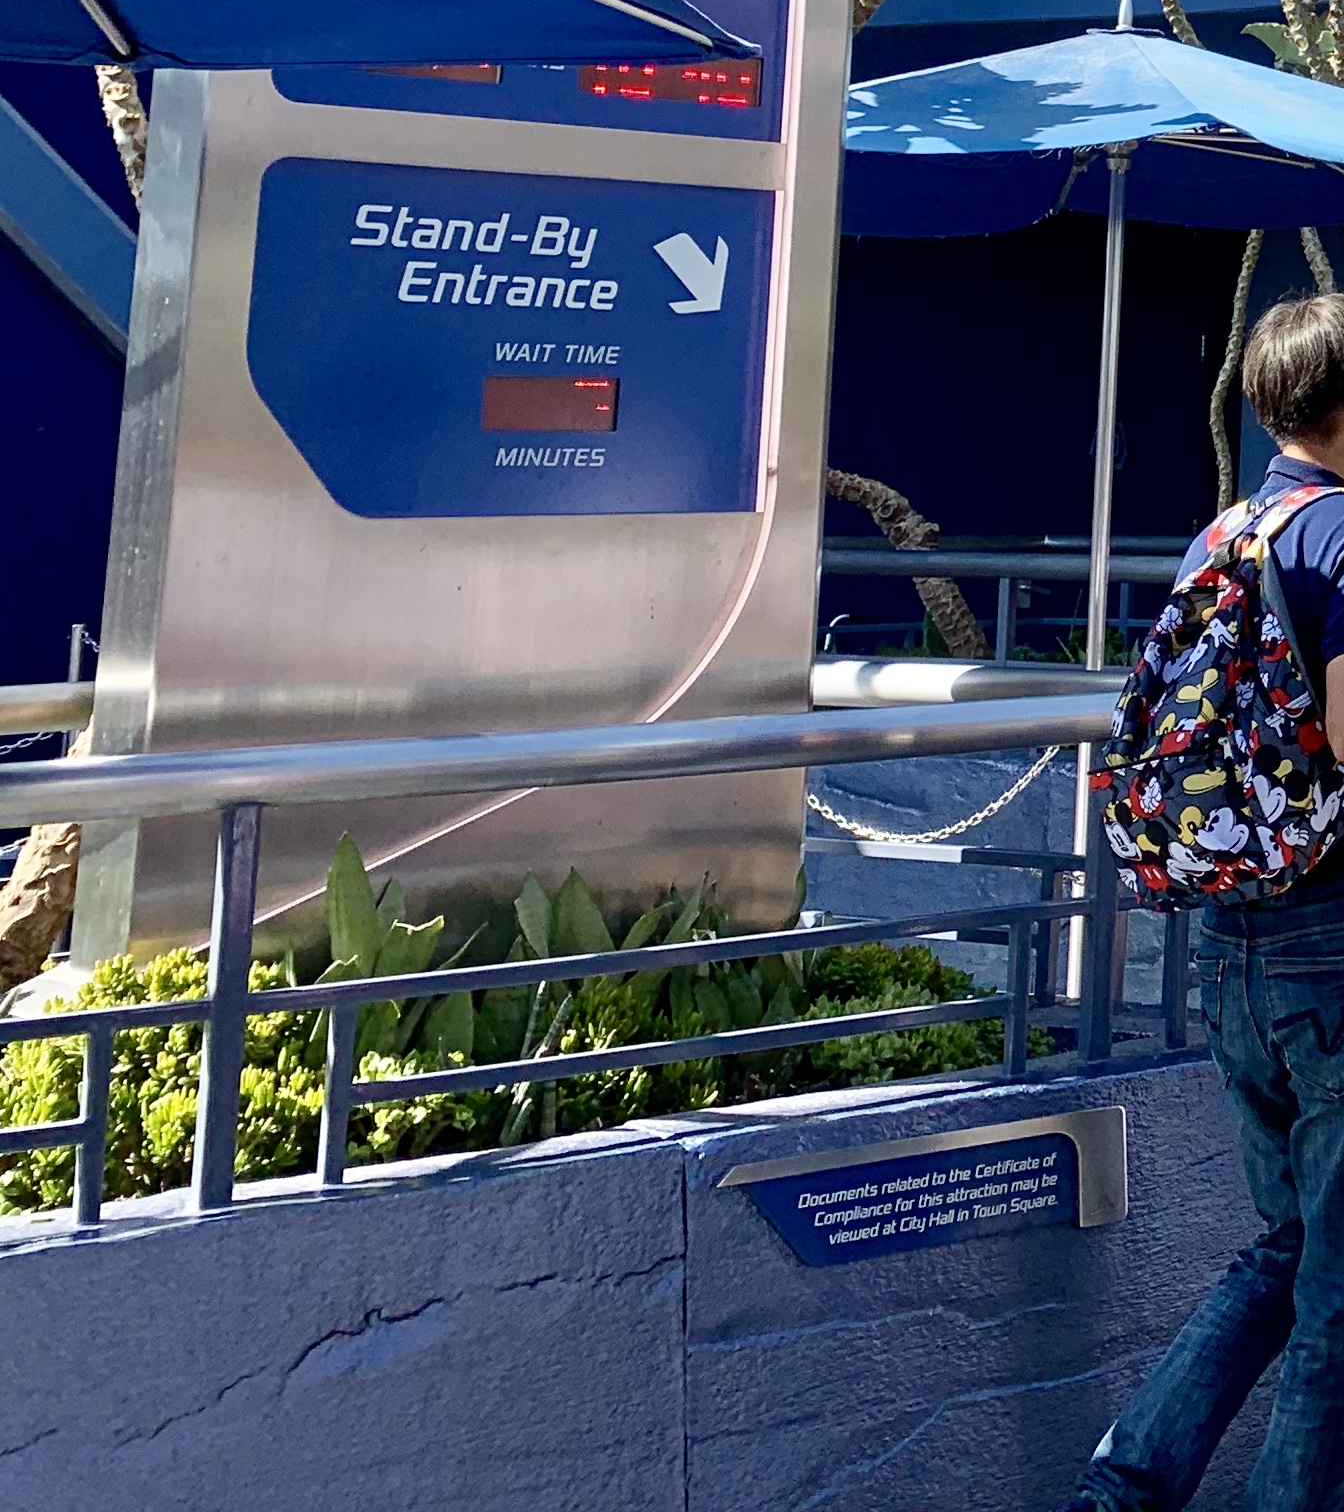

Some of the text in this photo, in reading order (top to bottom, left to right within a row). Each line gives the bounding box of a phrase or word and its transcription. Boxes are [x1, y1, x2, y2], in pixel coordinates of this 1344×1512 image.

[350, 204, 599, 269] Stand-By
[397, 261, 619, 311] Entrance
[495, 342, 621, 365] WAIT TIME
[495, 447, 606, 468] MINUTES
[798, 1152, 1058, 1209] Documents related to the Certificate of
[813, 1172, 1058, 1228] Compliance for this attraction may be
[827, 1192, 1059, 1246] viewed at City Hall in Town Square.
